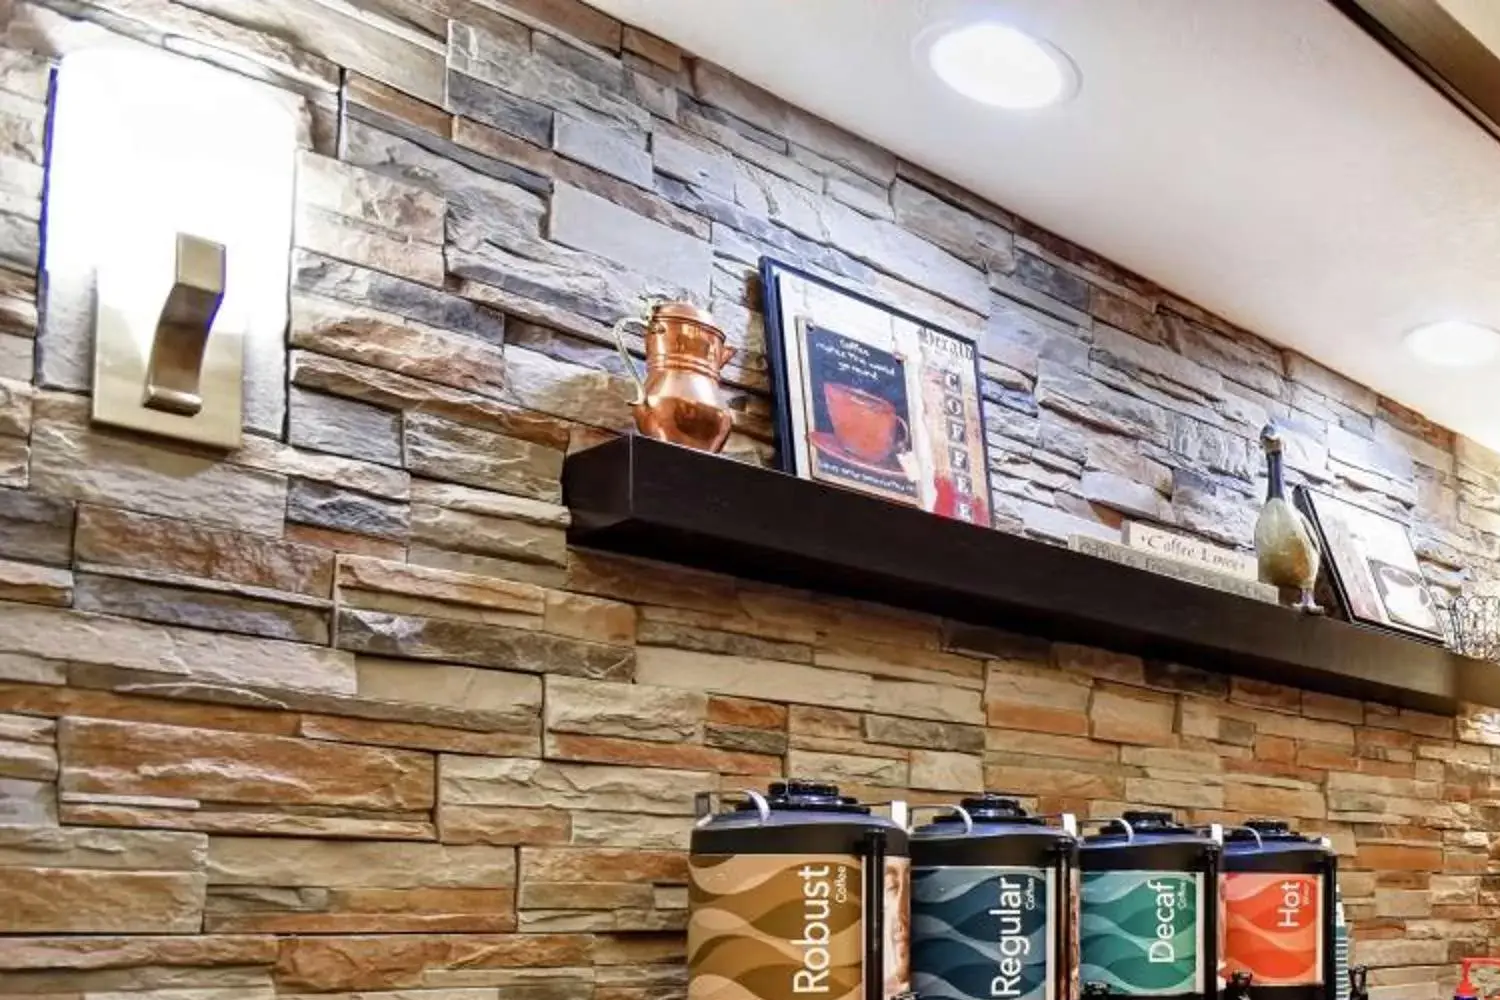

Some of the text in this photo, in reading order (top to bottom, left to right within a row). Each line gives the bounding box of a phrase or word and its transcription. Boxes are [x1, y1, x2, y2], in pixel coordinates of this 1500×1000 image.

[790, 866, 831, 993] Robust
[988, 877, 1030, 996] Regular
[1147, 879, 1175, 963] Decaf
[1276, 881, 1300, 928] Hot
